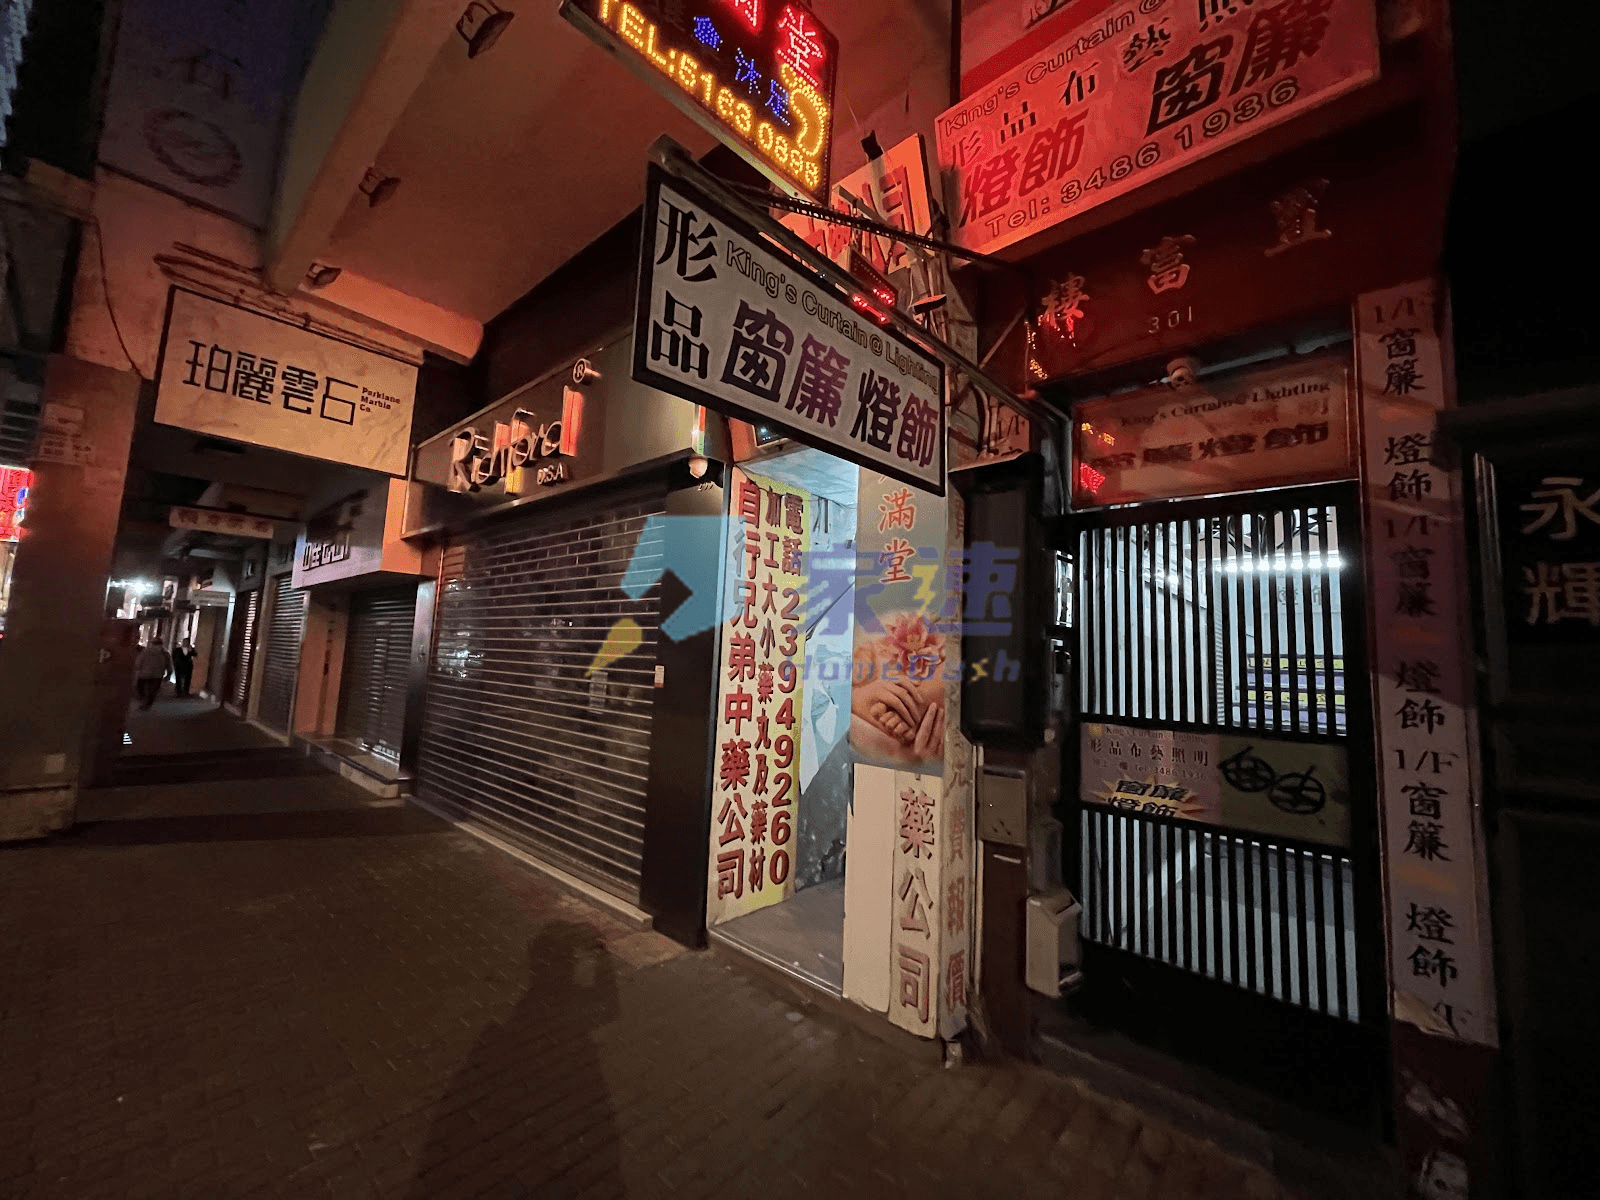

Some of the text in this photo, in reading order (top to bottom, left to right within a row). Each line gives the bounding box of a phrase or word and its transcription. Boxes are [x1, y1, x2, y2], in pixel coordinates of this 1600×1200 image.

[944, 82, 1020, 137] King's
[1025, 12, 1134, 84] Curtain
[959, 108, 1089, 228] 燈飾
[985, 196, 1050, 237] Tel:
[1060, 141, 1161, 204] 3486
[1174, 76, 1301, 151] 1936
[651, 197, 718, 381] 形品
[725, 240, 798, 304] King's
[802, 290, 867, 348] Curtain
[869, 333, 883, 356] @
[885, 344, 939, 395] Lighting
[360, 395, 392, 410] Marble
[1378, 327, 1426, 396] 窗簾
[1384, 433, 1432, 503] 燈飾
[878, 474, 916, 584] 滿堂
[1394, 660, 1445, 735] 燈飾
[1395, 749, 1460, 774] 1/F
[1400, 781, 1452, 862] 窗簾
[898, 773, 936, 1023] 藥公司
[1406, 902, 1458, 988] 燈飾
